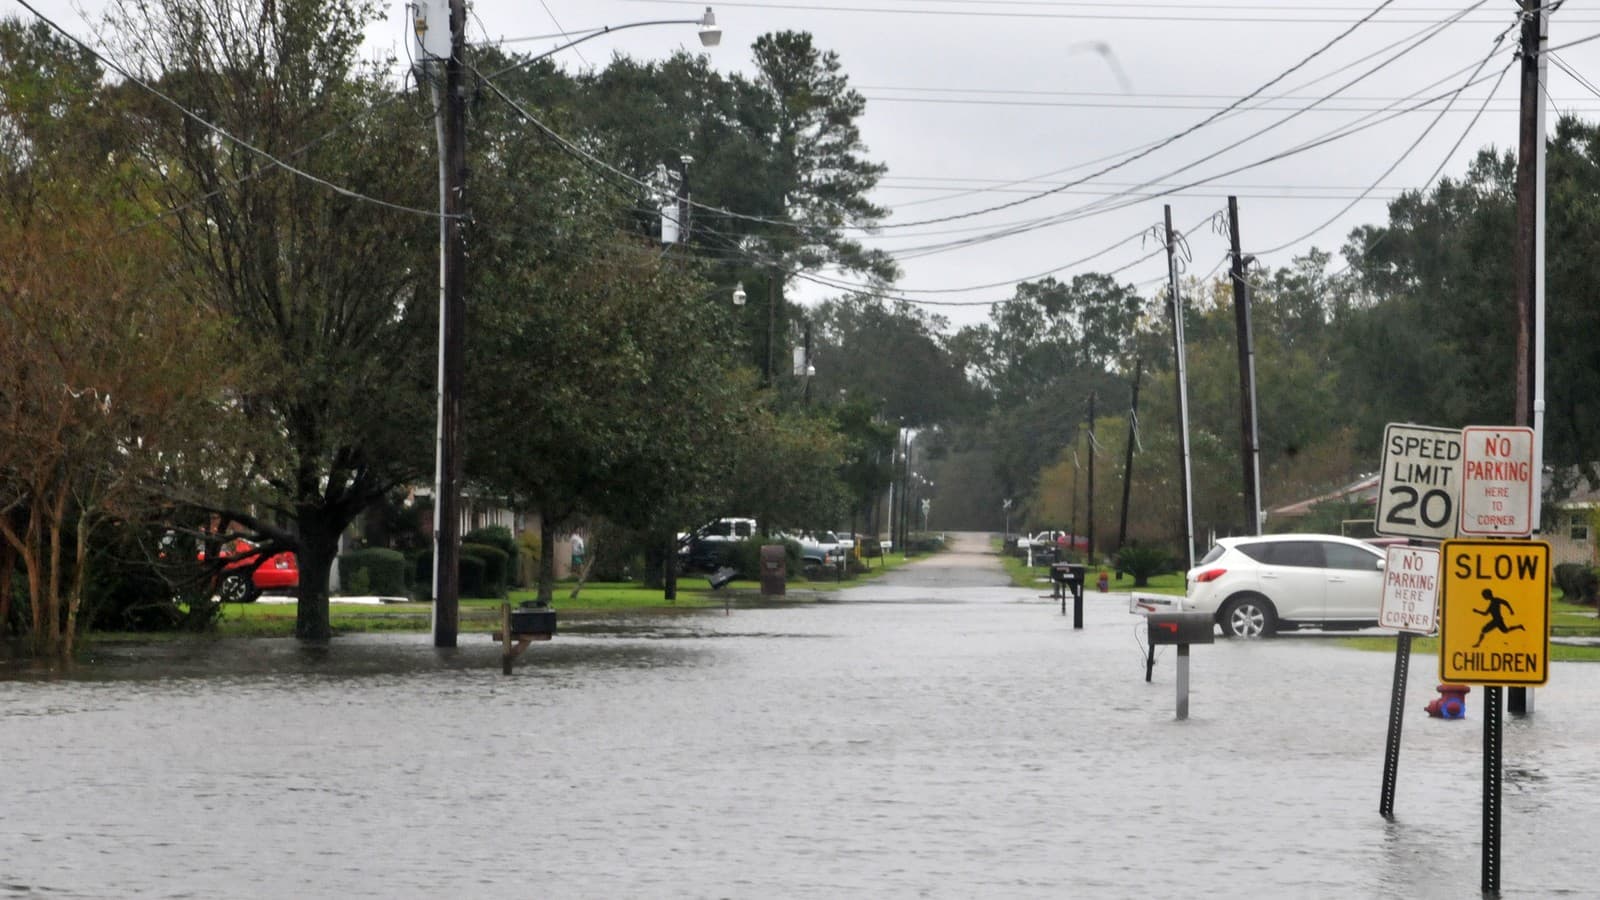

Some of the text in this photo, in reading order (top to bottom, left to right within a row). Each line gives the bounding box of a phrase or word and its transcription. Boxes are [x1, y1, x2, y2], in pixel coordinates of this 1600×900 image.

[1390, 435, 1461, 461] SPEED
[1485, 437, 1512, 457] NO
[1394, 462, 1453, 486] LIMIT
[1466, 460, 1528, 482] PARKING
[1484, 487, 1509, 498] HERE
[1386, 485, 1452, 528] 20
[1492, 501, 1503, 511] TO
[1477, 515, 1515, 526] CORNER
[1402, 555, 1424, 571] NO
[1455, 554, 1539, 580] SLOW
[1388, 572, 1434, 591] PARKING
[1394, 589, 1424, 602] HERE
[1402, 601, 1415, 612] TO
[1386, 612, 1429, 625] CORNER
[1452, 652, 1537, 673] CHILDREN
